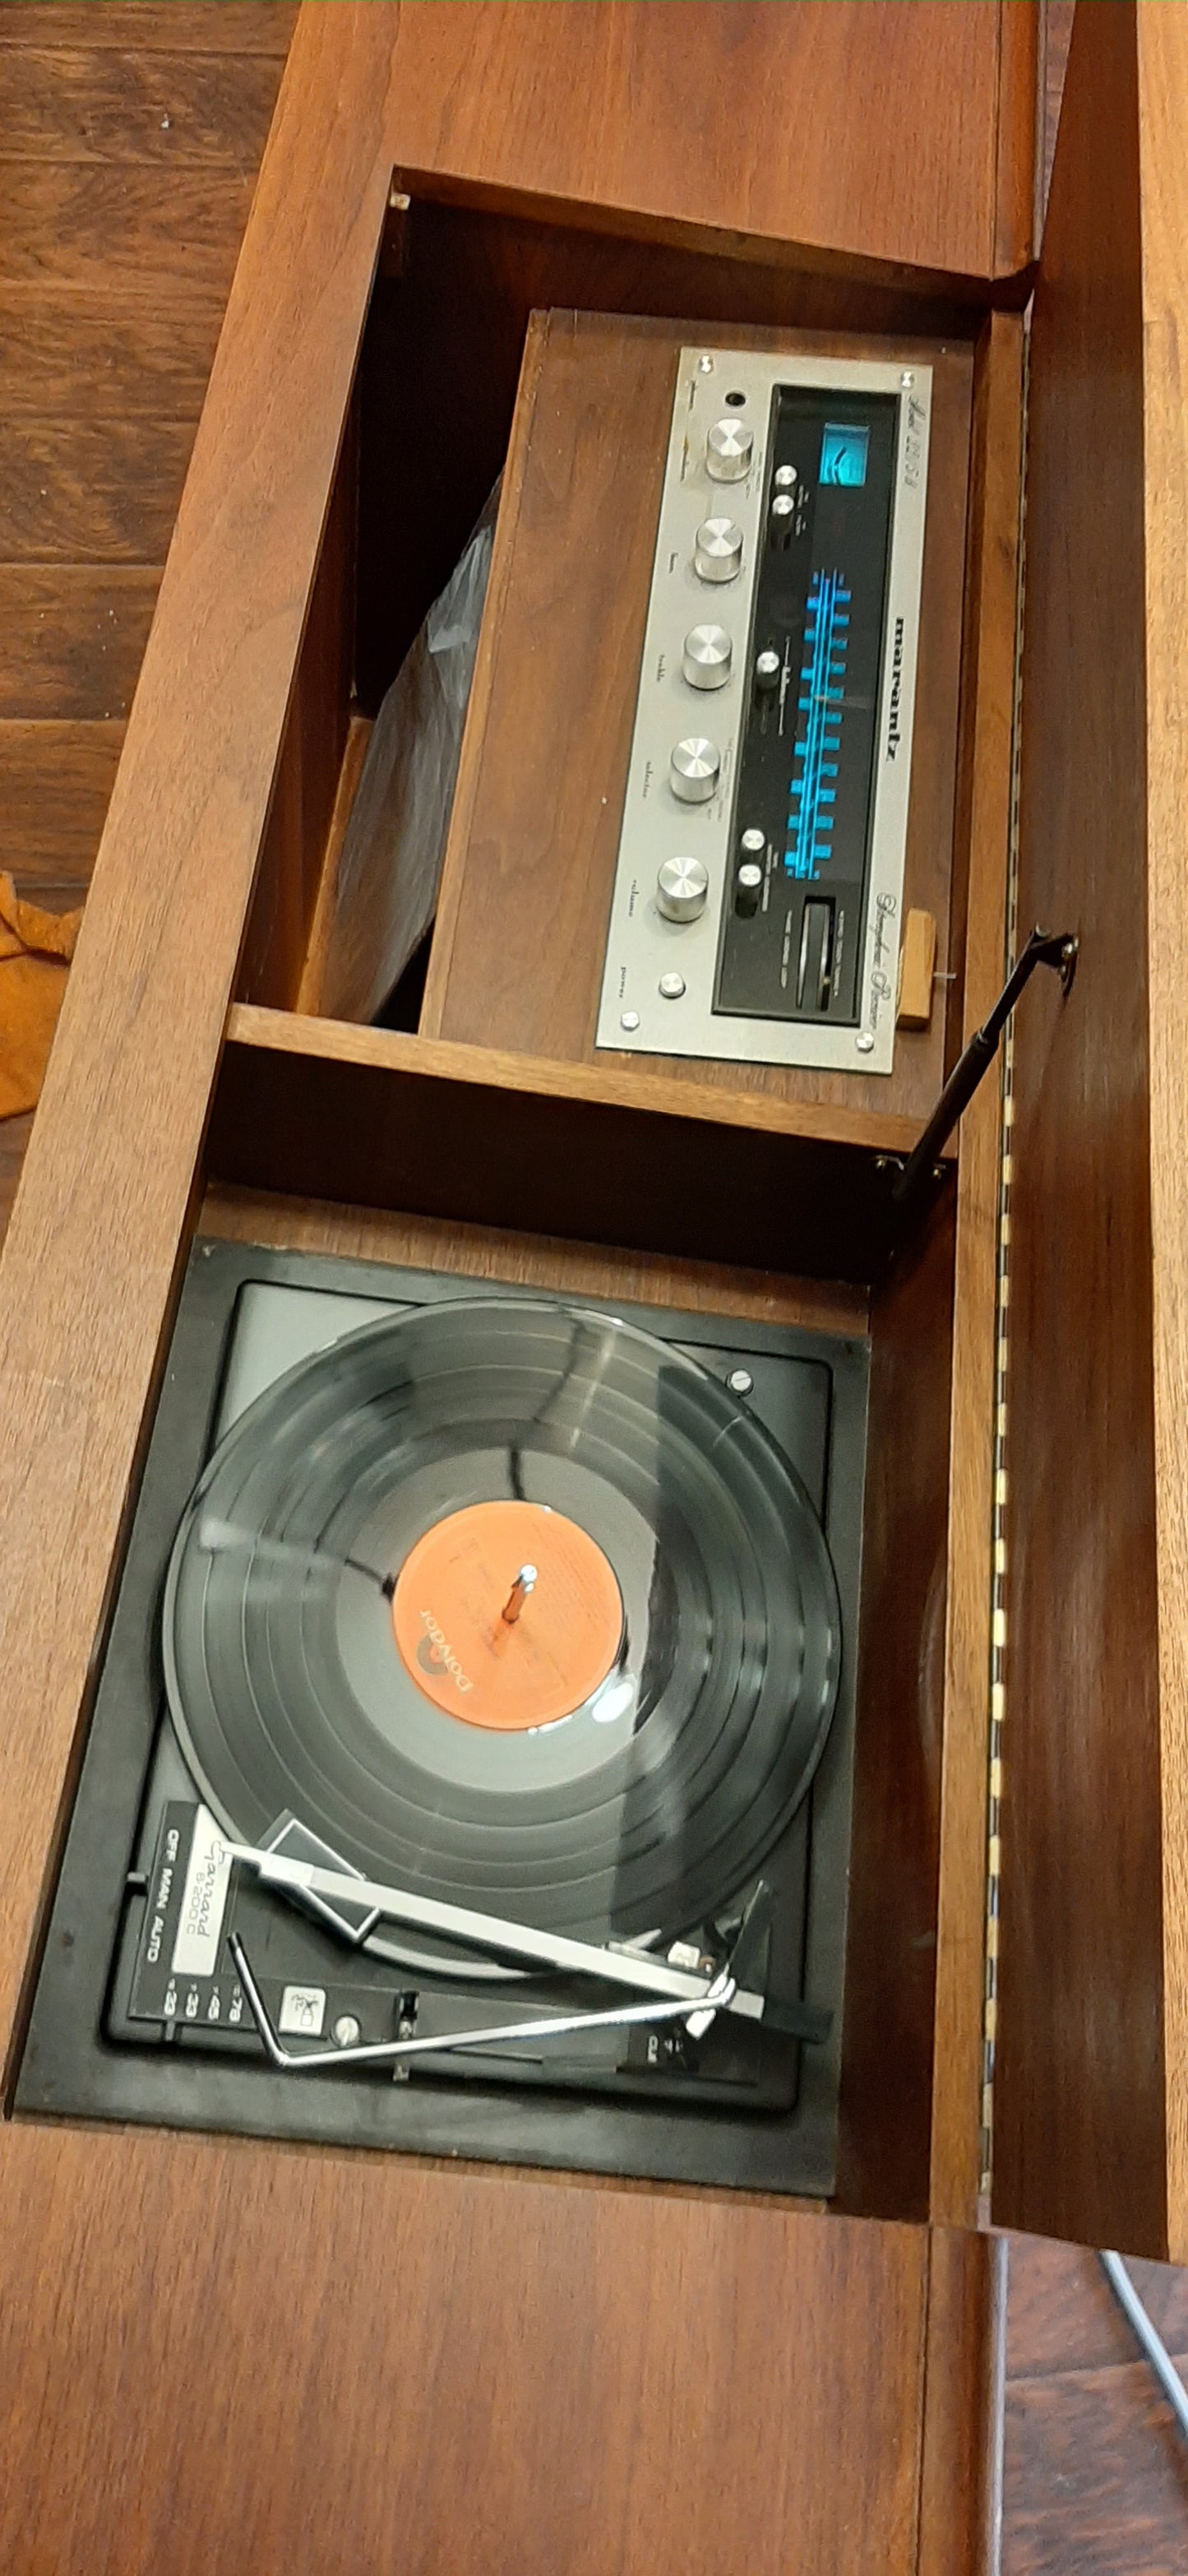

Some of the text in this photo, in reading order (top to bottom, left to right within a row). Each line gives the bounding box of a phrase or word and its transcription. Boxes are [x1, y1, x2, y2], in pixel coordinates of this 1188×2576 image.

[886, 618, 904, 762] marantz
[618, 966, 627, 999] power
[419, 1609, 474, 1694] Polydor
[147, 1828, 179, 1962] OFF MAN AUTO
[196, 1840, 225, 1937] Garrard
